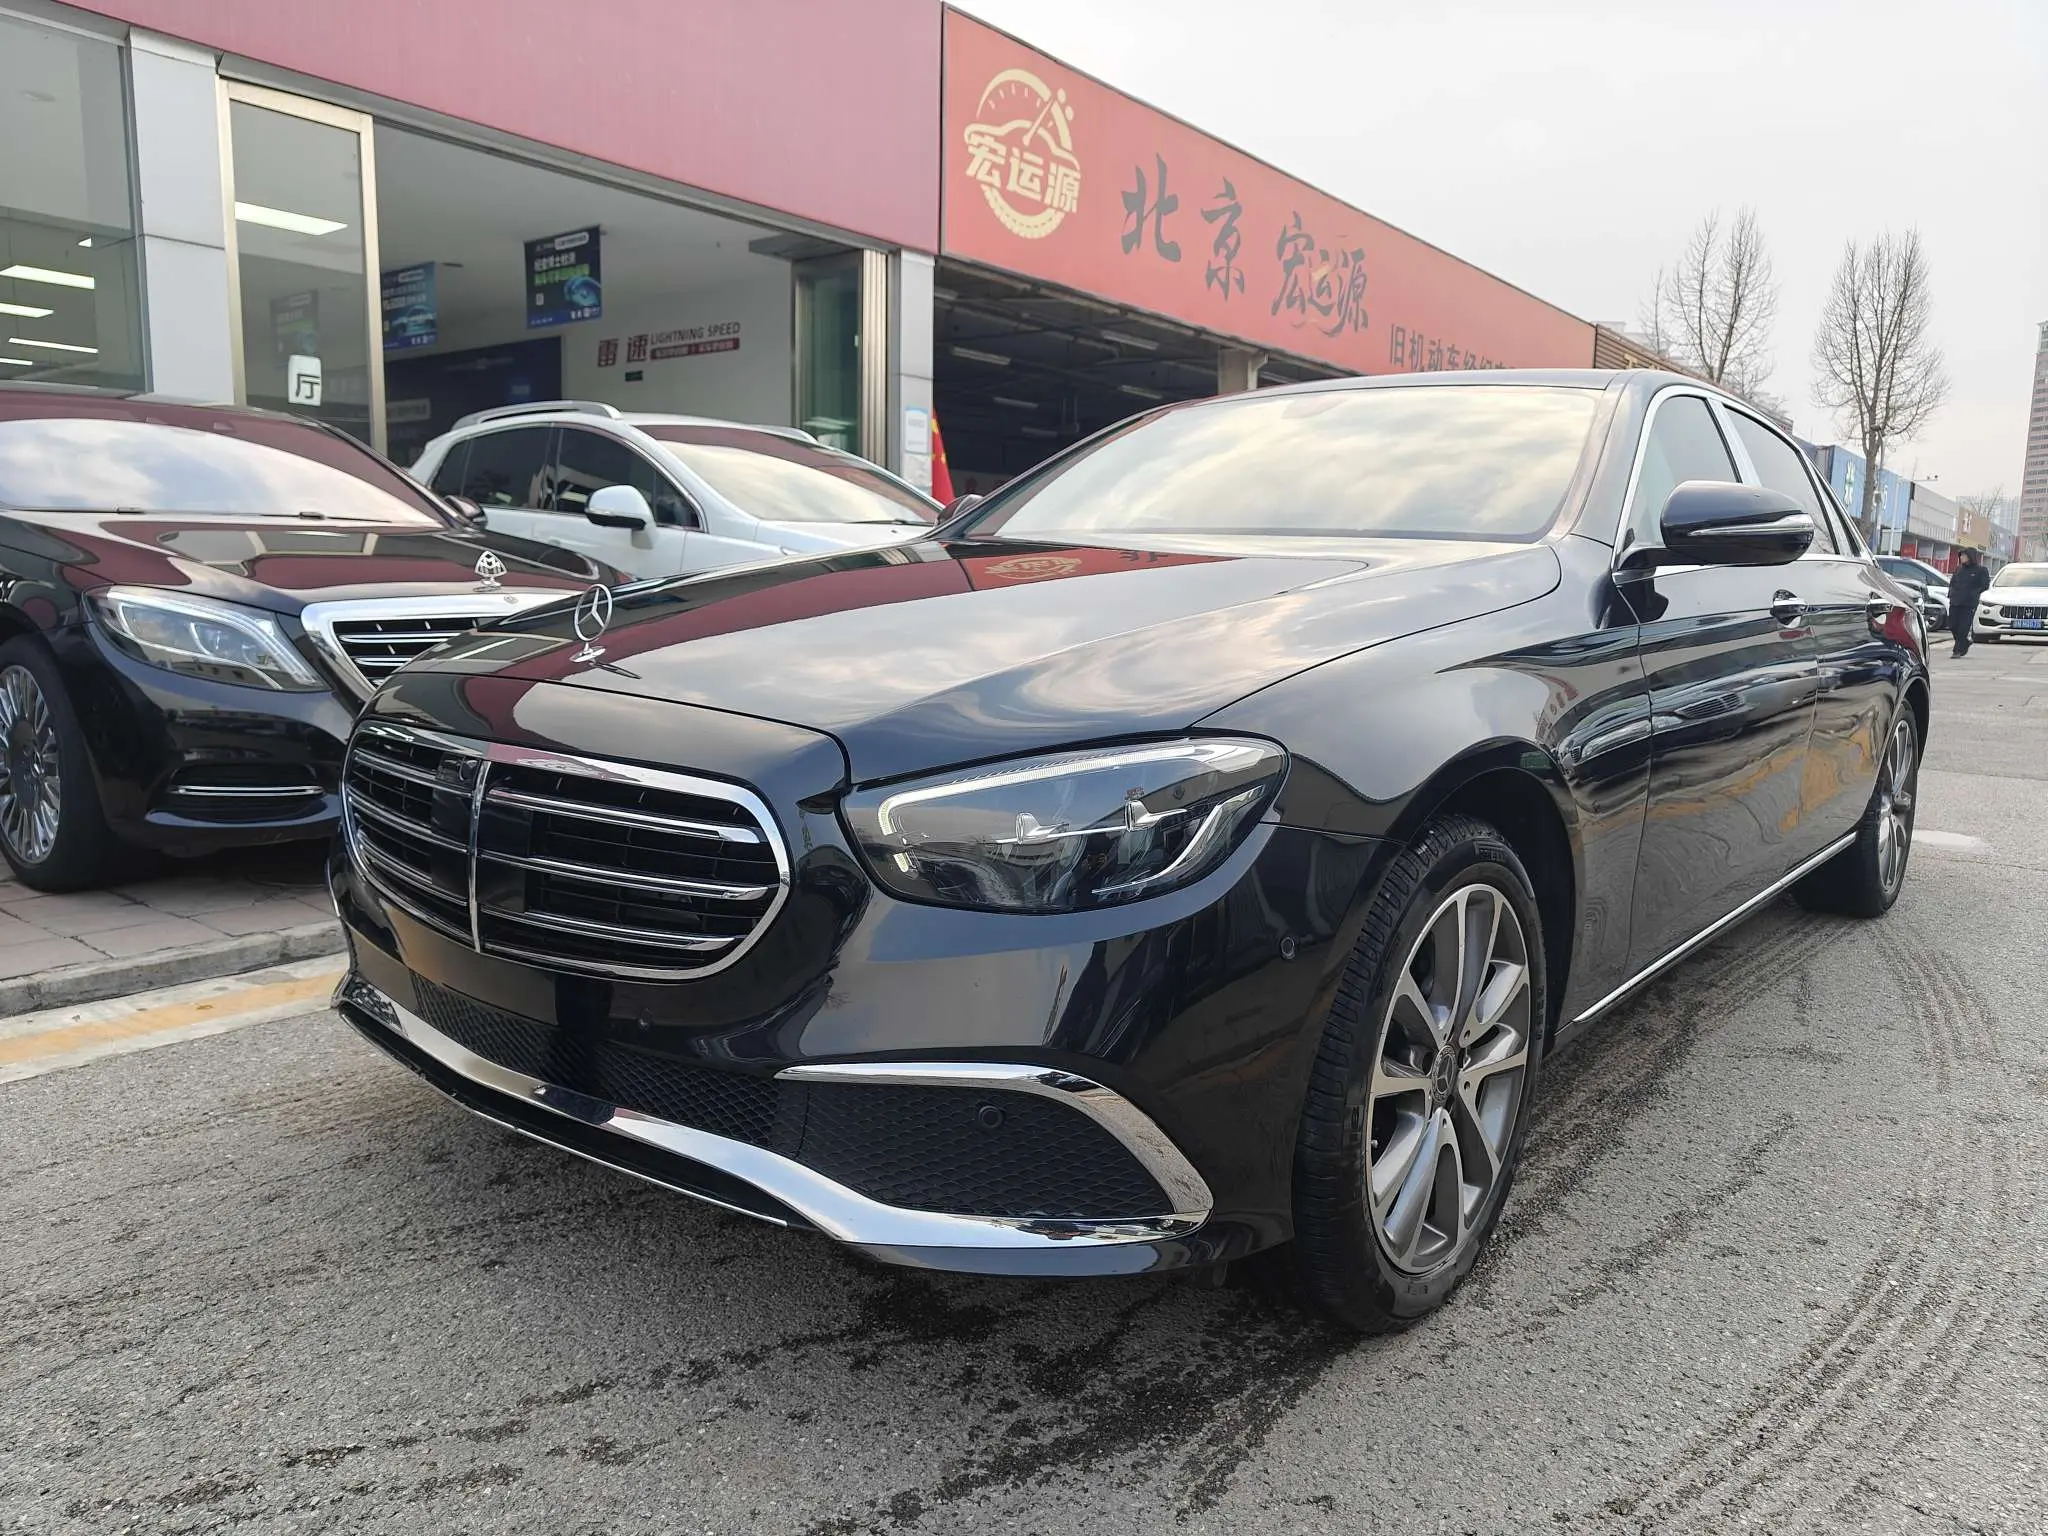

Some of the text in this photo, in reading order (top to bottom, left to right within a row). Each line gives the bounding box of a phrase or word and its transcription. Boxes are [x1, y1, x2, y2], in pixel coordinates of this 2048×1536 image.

[966, 133, 1081, 213] 宏运源
[650, 321, 740, 345] LIGHTNING SPEED
[295, 373, 320, 399] 厅
